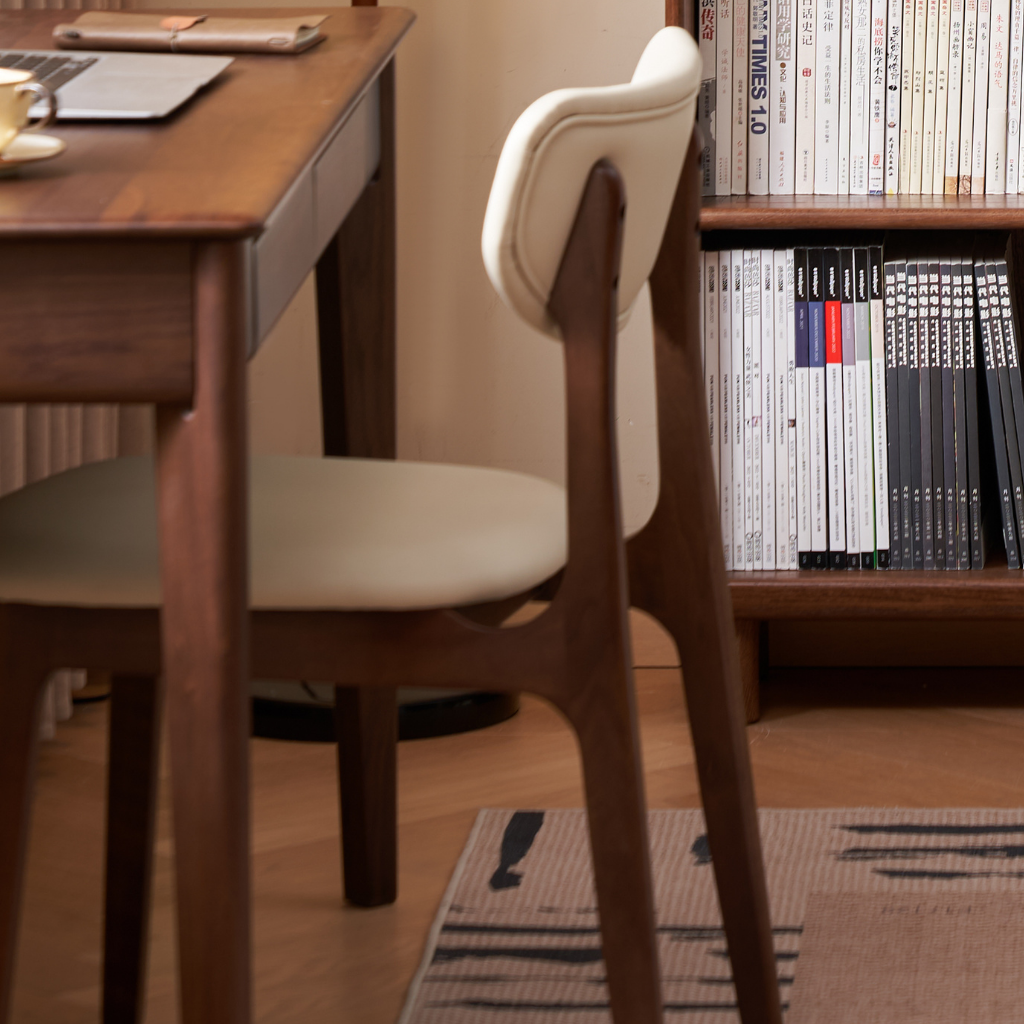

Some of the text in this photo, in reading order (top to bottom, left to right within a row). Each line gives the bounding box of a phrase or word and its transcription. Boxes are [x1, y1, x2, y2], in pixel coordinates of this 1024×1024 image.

[751, 34, 768, 100] TIMES
[873, 17, 884, 85] 海底捞你学不会
[751, 105, 767, 135] 1.0
